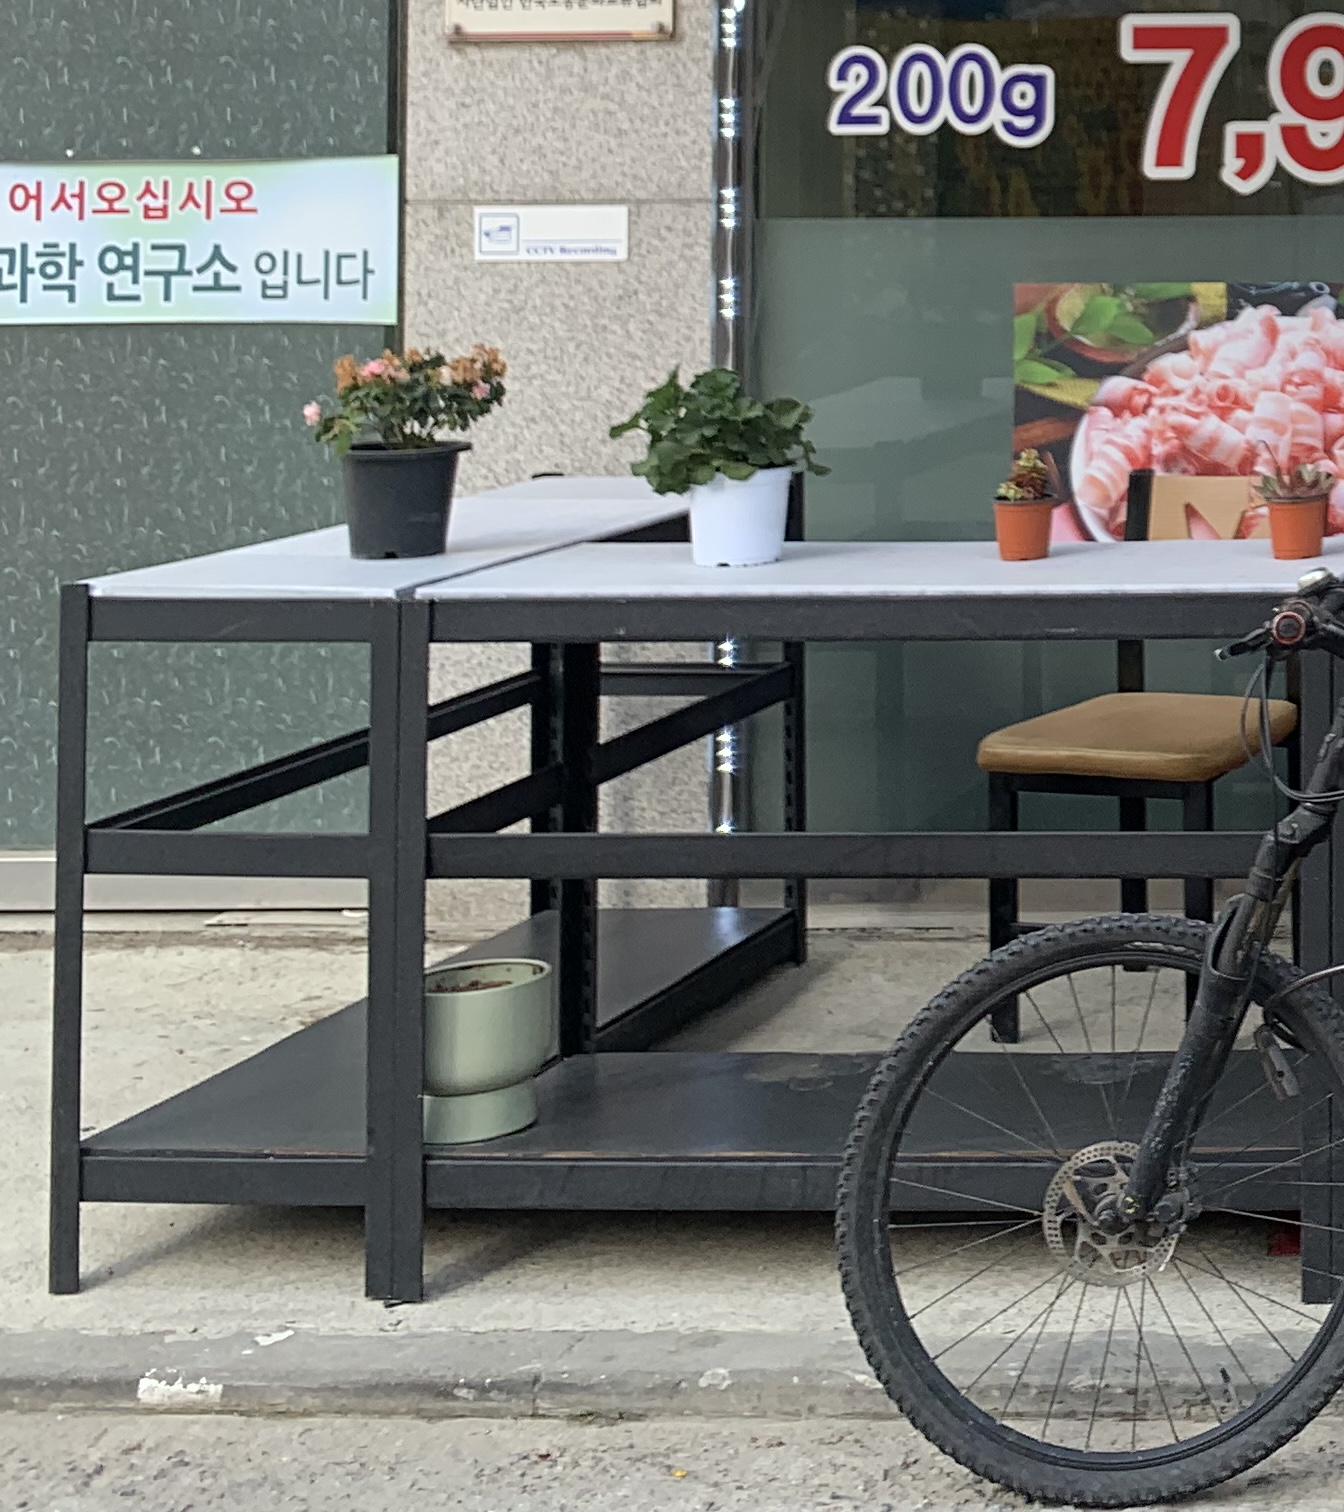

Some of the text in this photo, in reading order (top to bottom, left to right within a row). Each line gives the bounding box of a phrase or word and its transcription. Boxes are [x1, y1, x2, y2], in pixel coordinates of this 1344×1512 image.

[827, 44, 1055, 147] 200g
[9, 179, 258, 221] 어서오십시오
[98, 241, 241, 303] 연구소
[255, 248, 375, 302] 입니다
[559, 245, 617, 256] Recording
